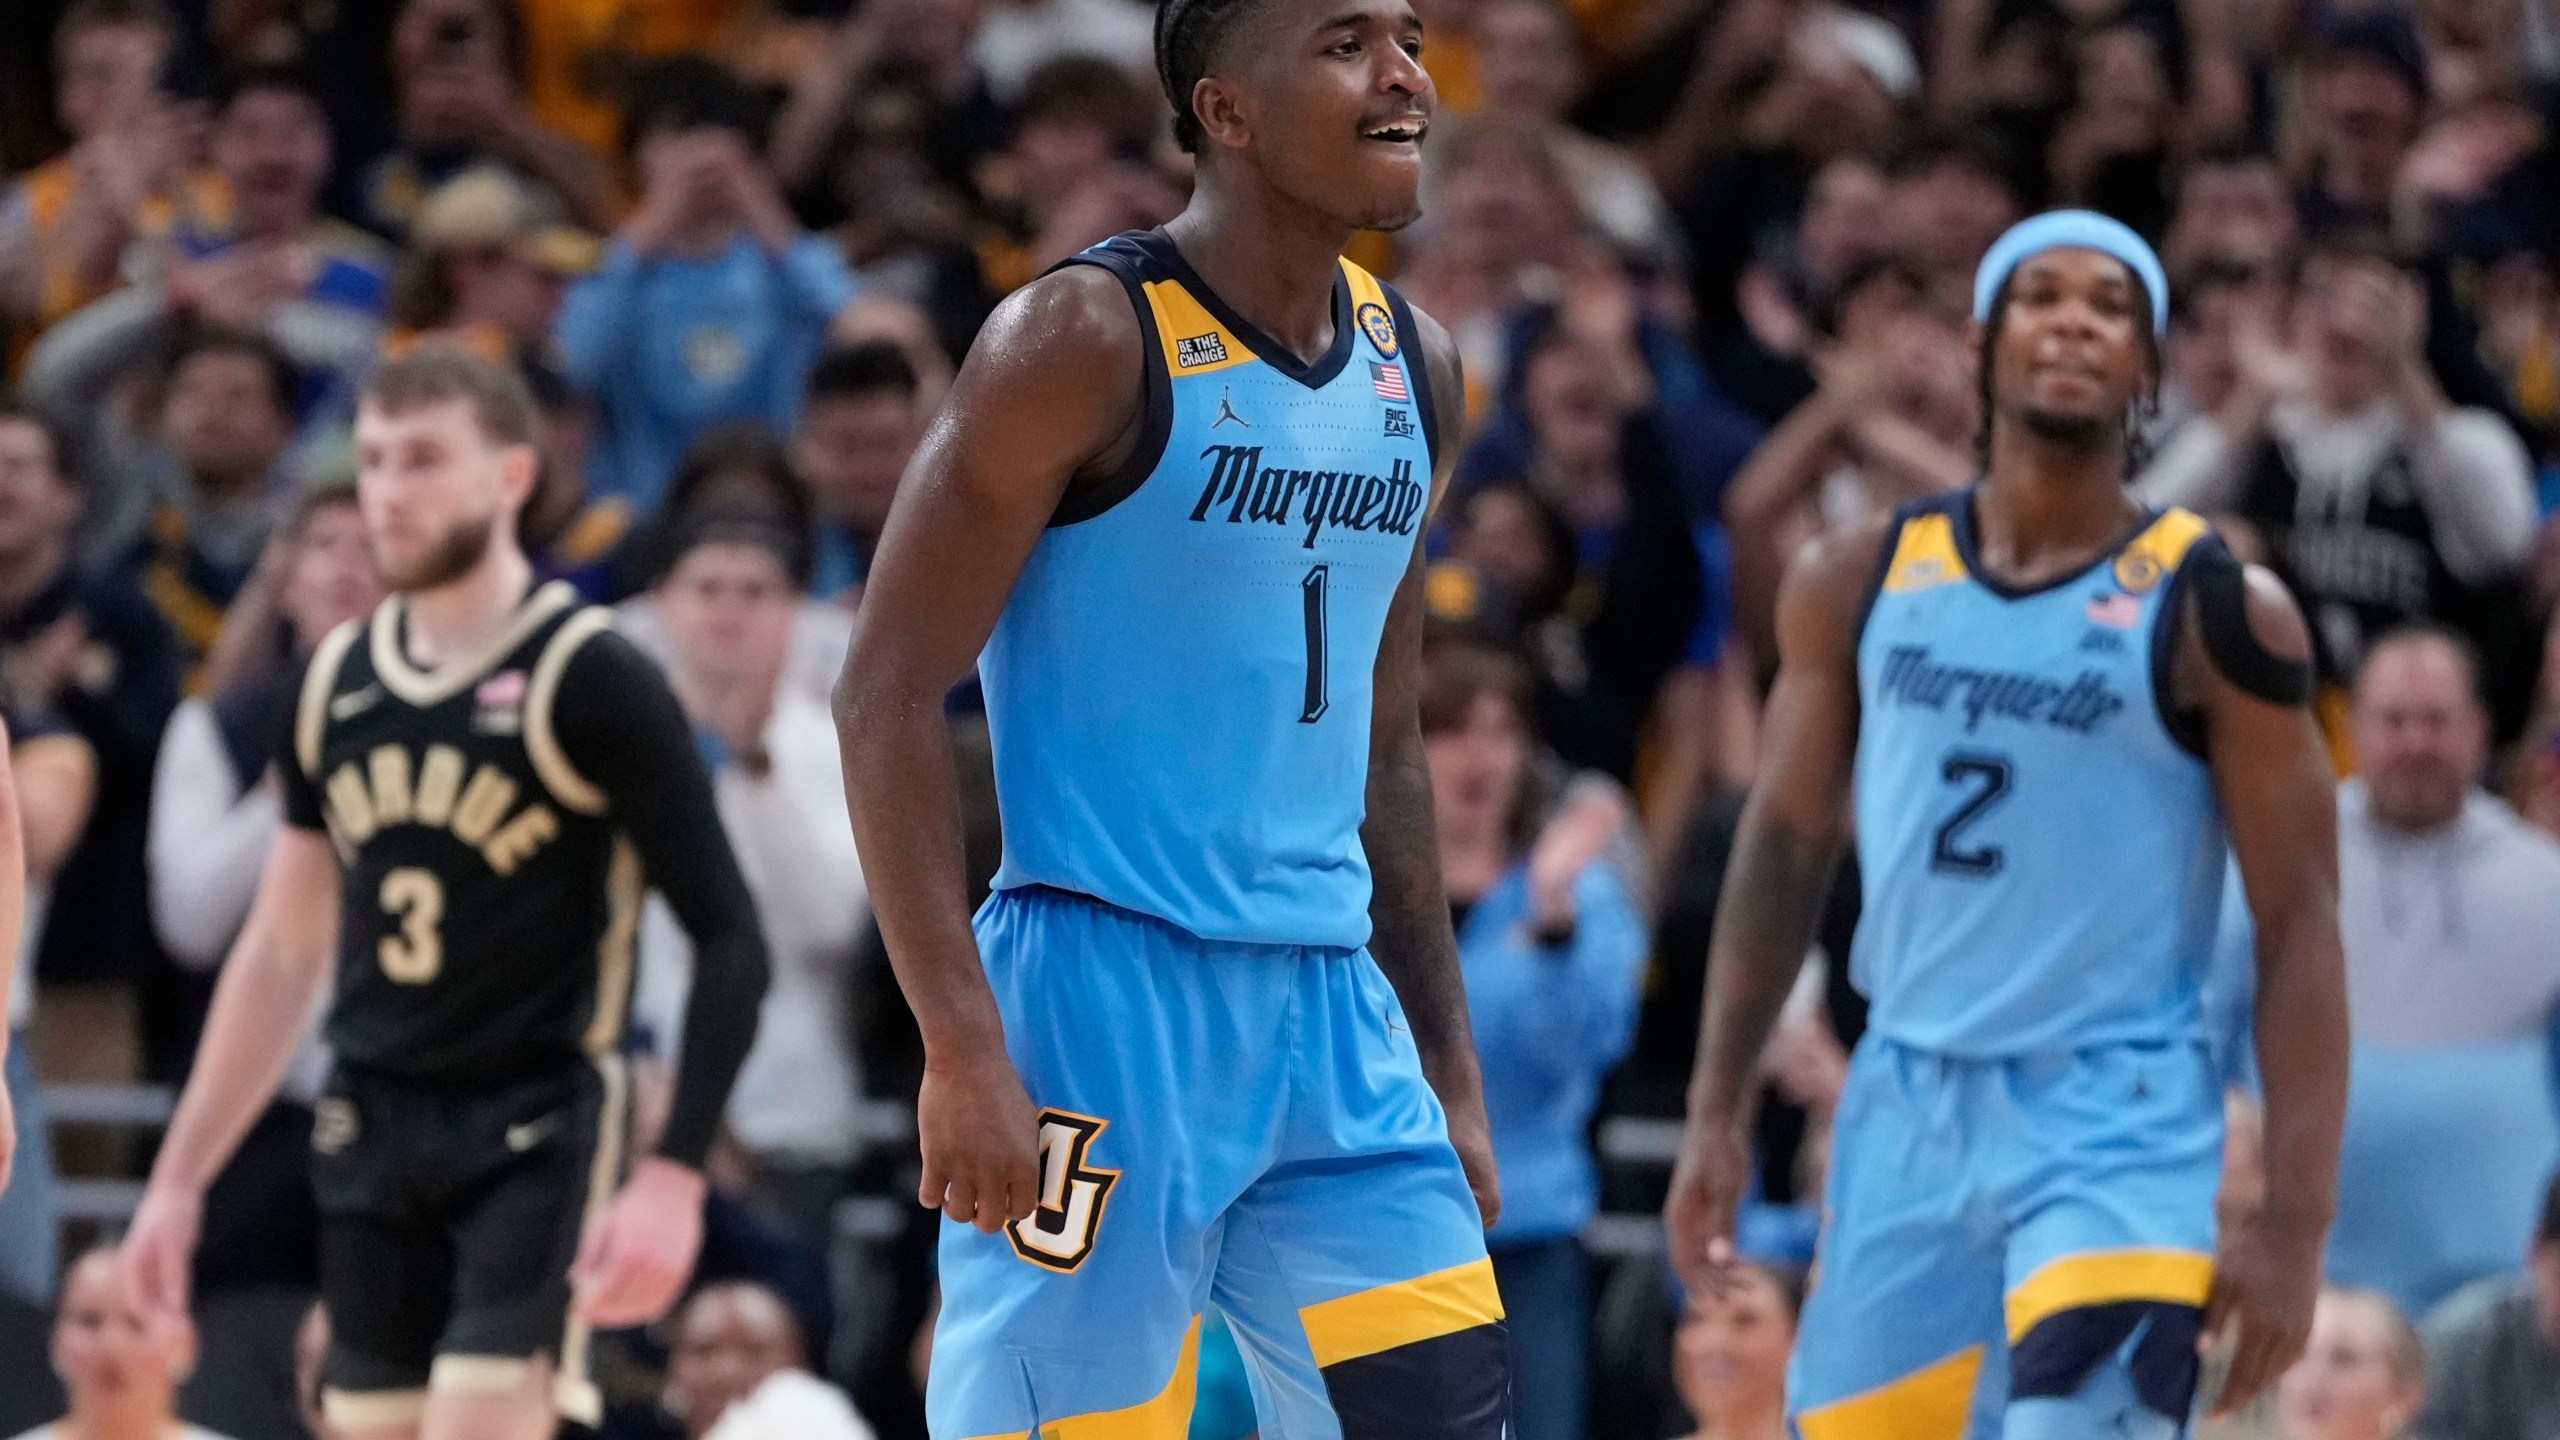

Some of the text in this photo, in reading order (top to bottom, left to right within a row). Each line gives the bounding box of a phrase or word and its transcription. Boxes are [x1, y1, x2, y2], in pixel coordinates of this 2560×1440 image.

[1178, 333, 1219, 353] BE THE
[1180, 345, 1227, 367] CHANGE
[1384, 420, 1415, 435] EAST
[1385, 408, 1407, 421] BIG
[1189, 445, 1422, 549] Marquette
[1298, 565, 1328, 723] 1
[1878, 644, 2123, 735] Marquette
[1929, 752, 2014, 877] 2
[377, 865, 444, 985] 3
